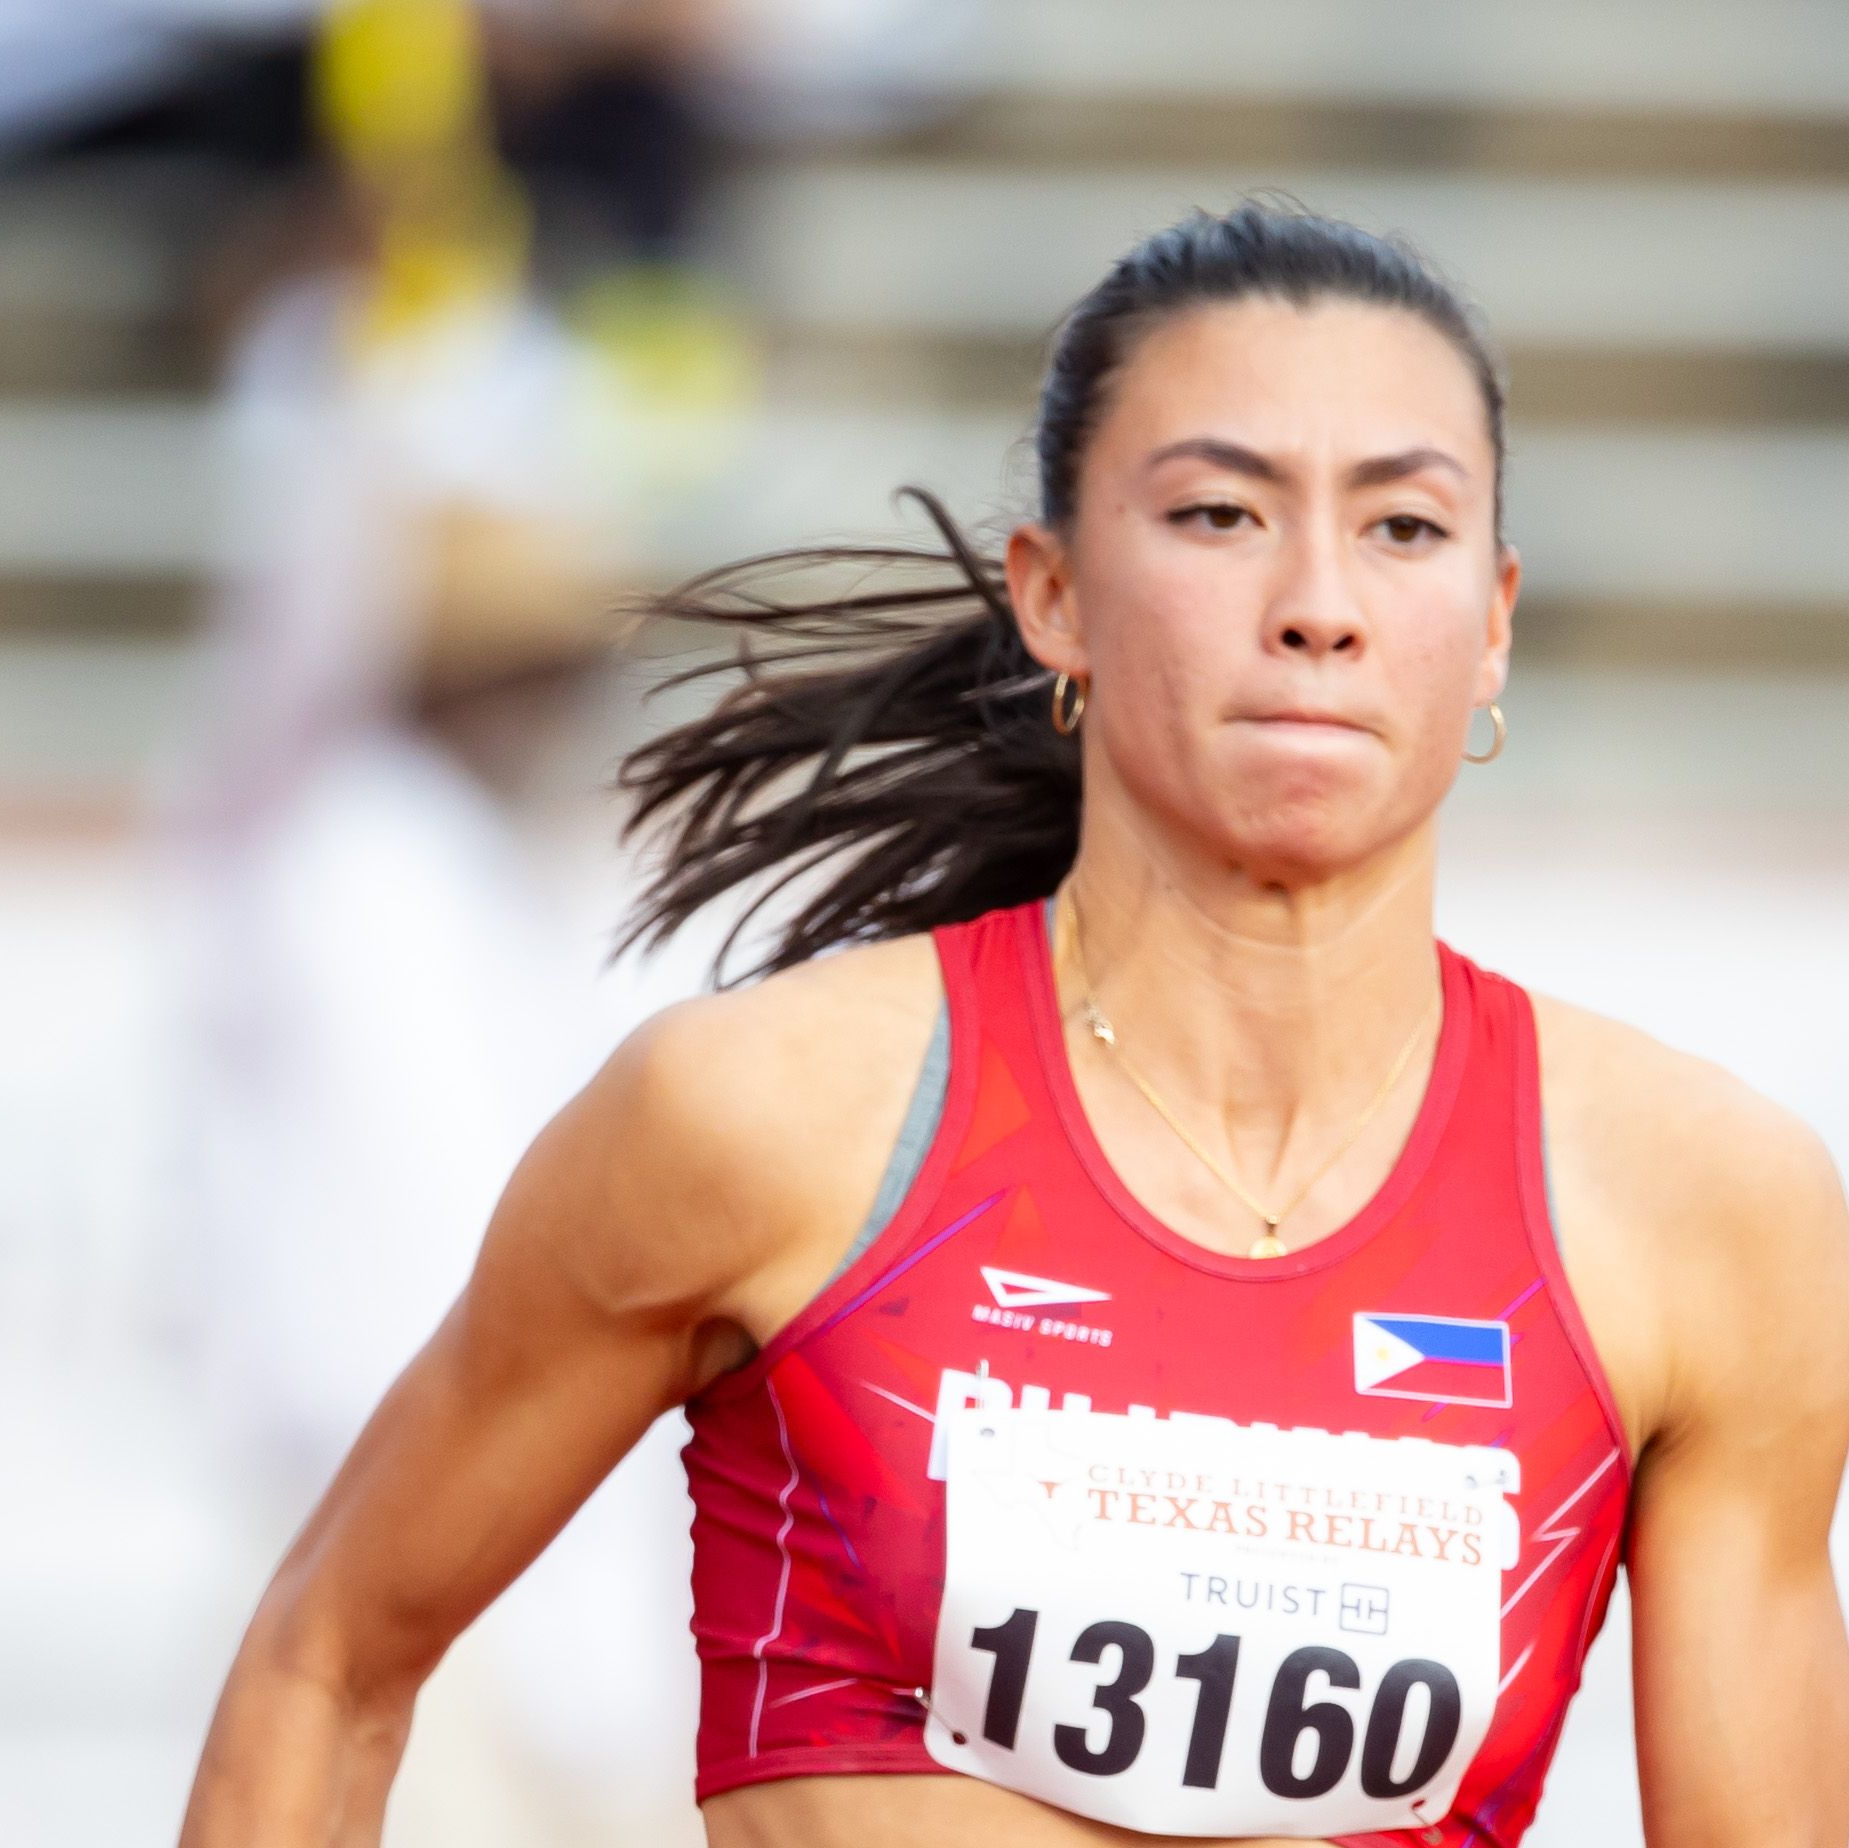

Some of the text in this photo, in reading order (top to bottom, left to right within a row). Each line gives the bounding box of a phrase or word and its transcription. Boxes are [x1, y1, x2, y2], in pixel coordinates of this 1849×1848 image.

[972, 1304, 1113, 1347] MASIV SPORTS
[1087, 1464, 1483, 1527] CLYDE LITTLEFIELD
[1087, 1487, 1269, 1538] TEXAS
[1285, 1509, 1482, 1567] RELAYS
[1180, 1571, 1327, 1616] TRUIST
[969, 1606, 1463, 1801] 13160
